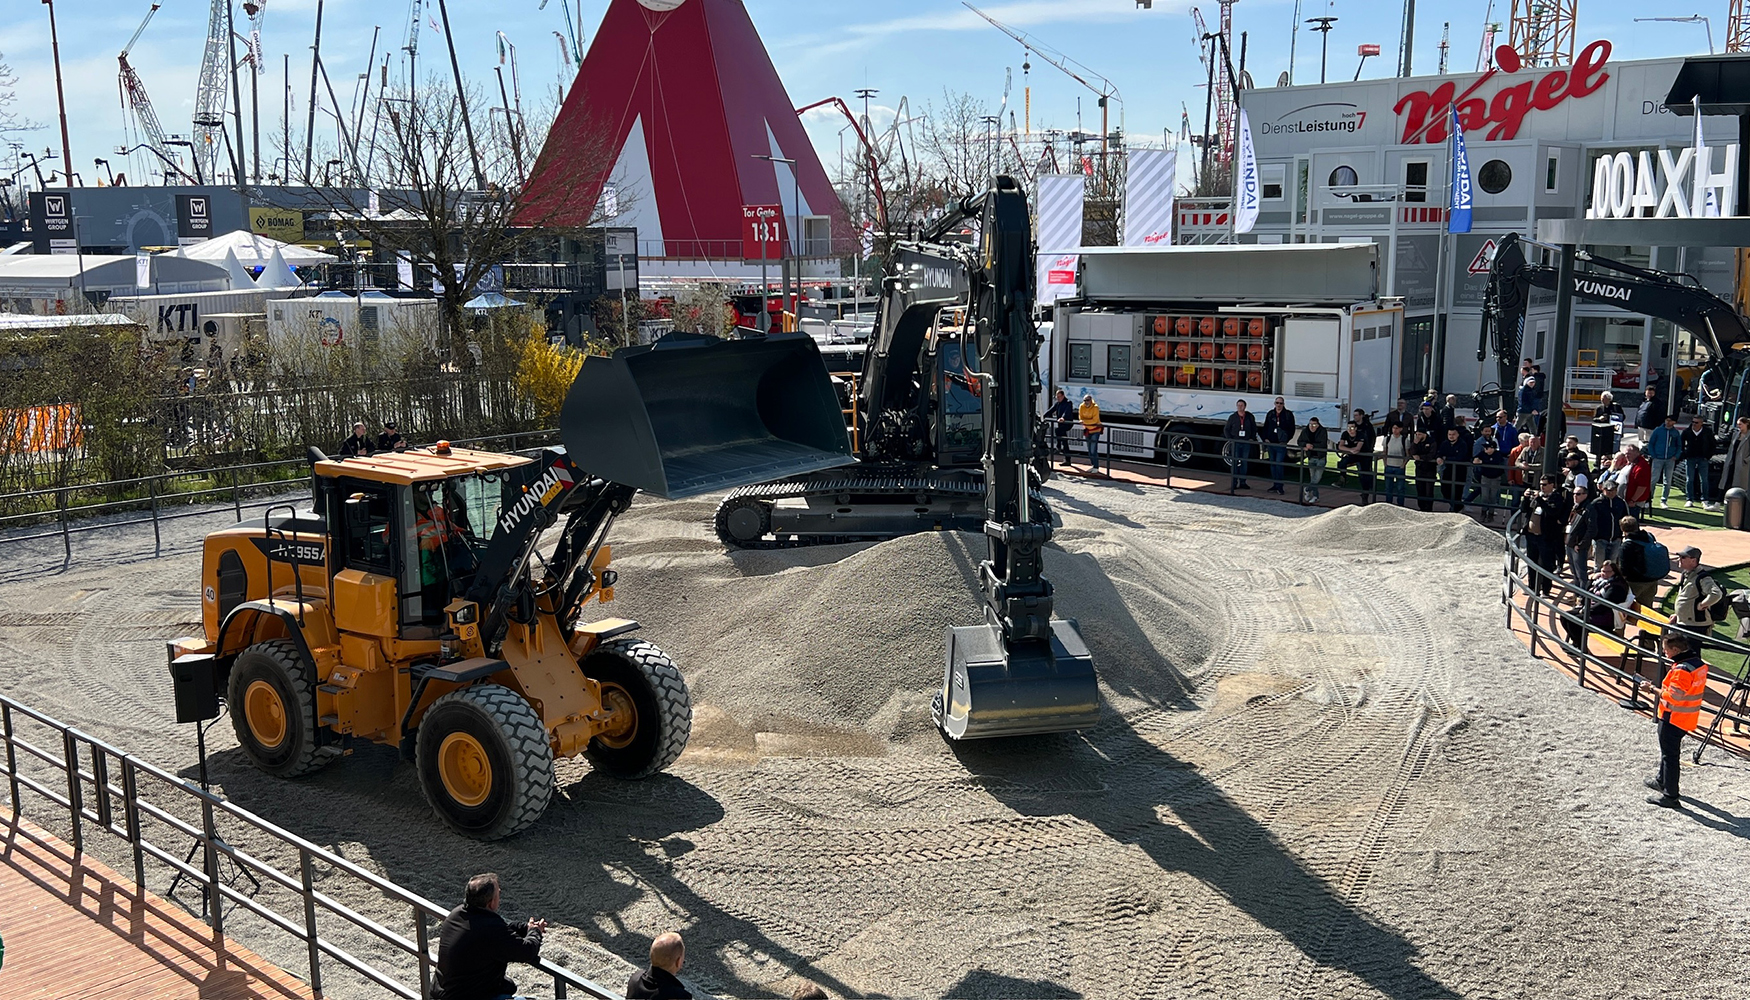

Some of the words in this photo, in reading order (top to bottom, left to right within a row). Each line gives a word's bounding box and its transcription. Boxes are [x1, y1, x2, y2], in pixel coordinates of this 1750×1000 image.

[1393, 39, 1612, 144] Nagel
[1641, 99, 1671, 115] Die
[1261, 120, 1356, 134] DienstLeistung
[1356, 111, 1367, 130] 7
[267, 217, 295, 227] BOMAG
[743, 208, 755, 218] Tor
[752, 222, 780, 241] 13.1
[1144, 232, 1169, 243] Nagel
[923, 268, 952, 288] HYUNDAI
[1573, 278, 1632, 301] YUNDAI
[500, 466, 560, 534] HYUNDAI
[205, 589, 215, 600] 40
